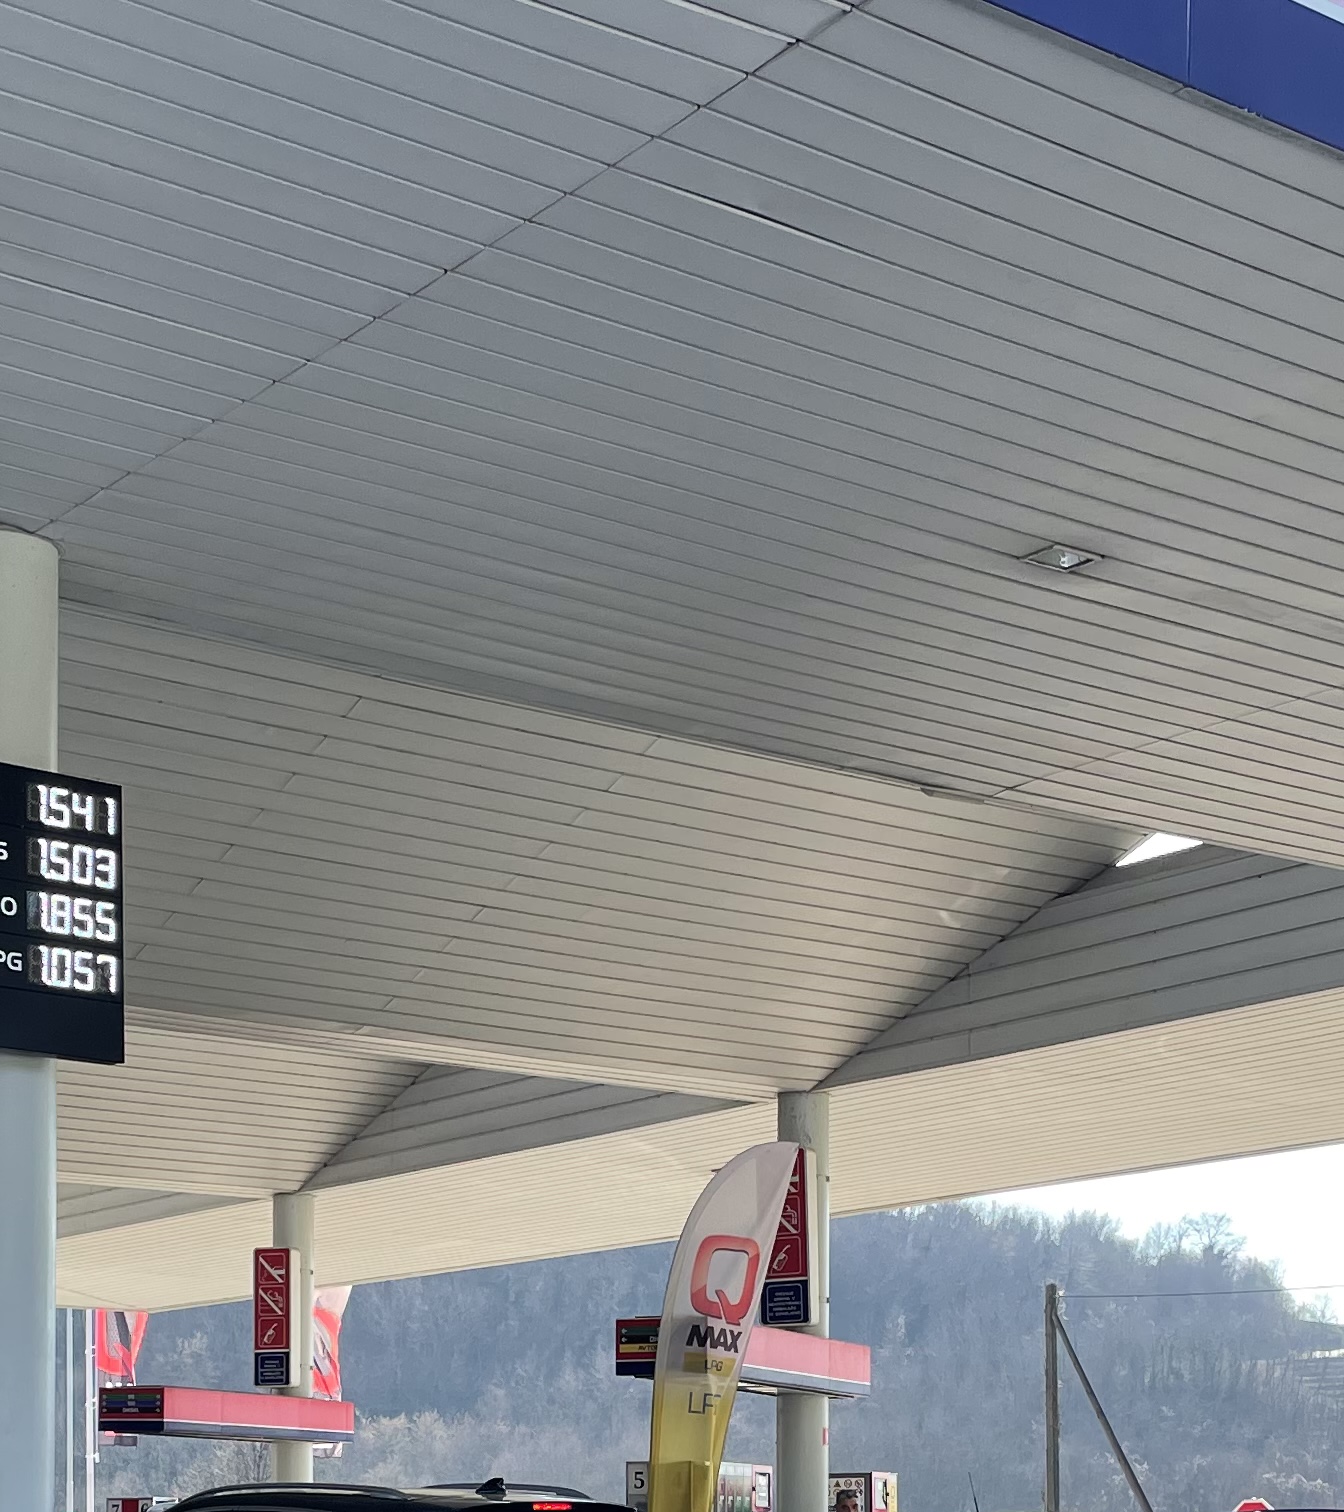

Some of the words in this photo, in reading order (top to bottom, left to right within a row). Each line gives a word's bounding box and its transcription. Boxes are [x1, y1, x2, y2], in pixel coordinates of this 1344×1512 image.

[690, 1234, 760, 1326] Q
[685, 1324, 743, 1353] MAX
[704, 1359, 724, 1373] LPG
[633, 1471, 645, 1489] 5
